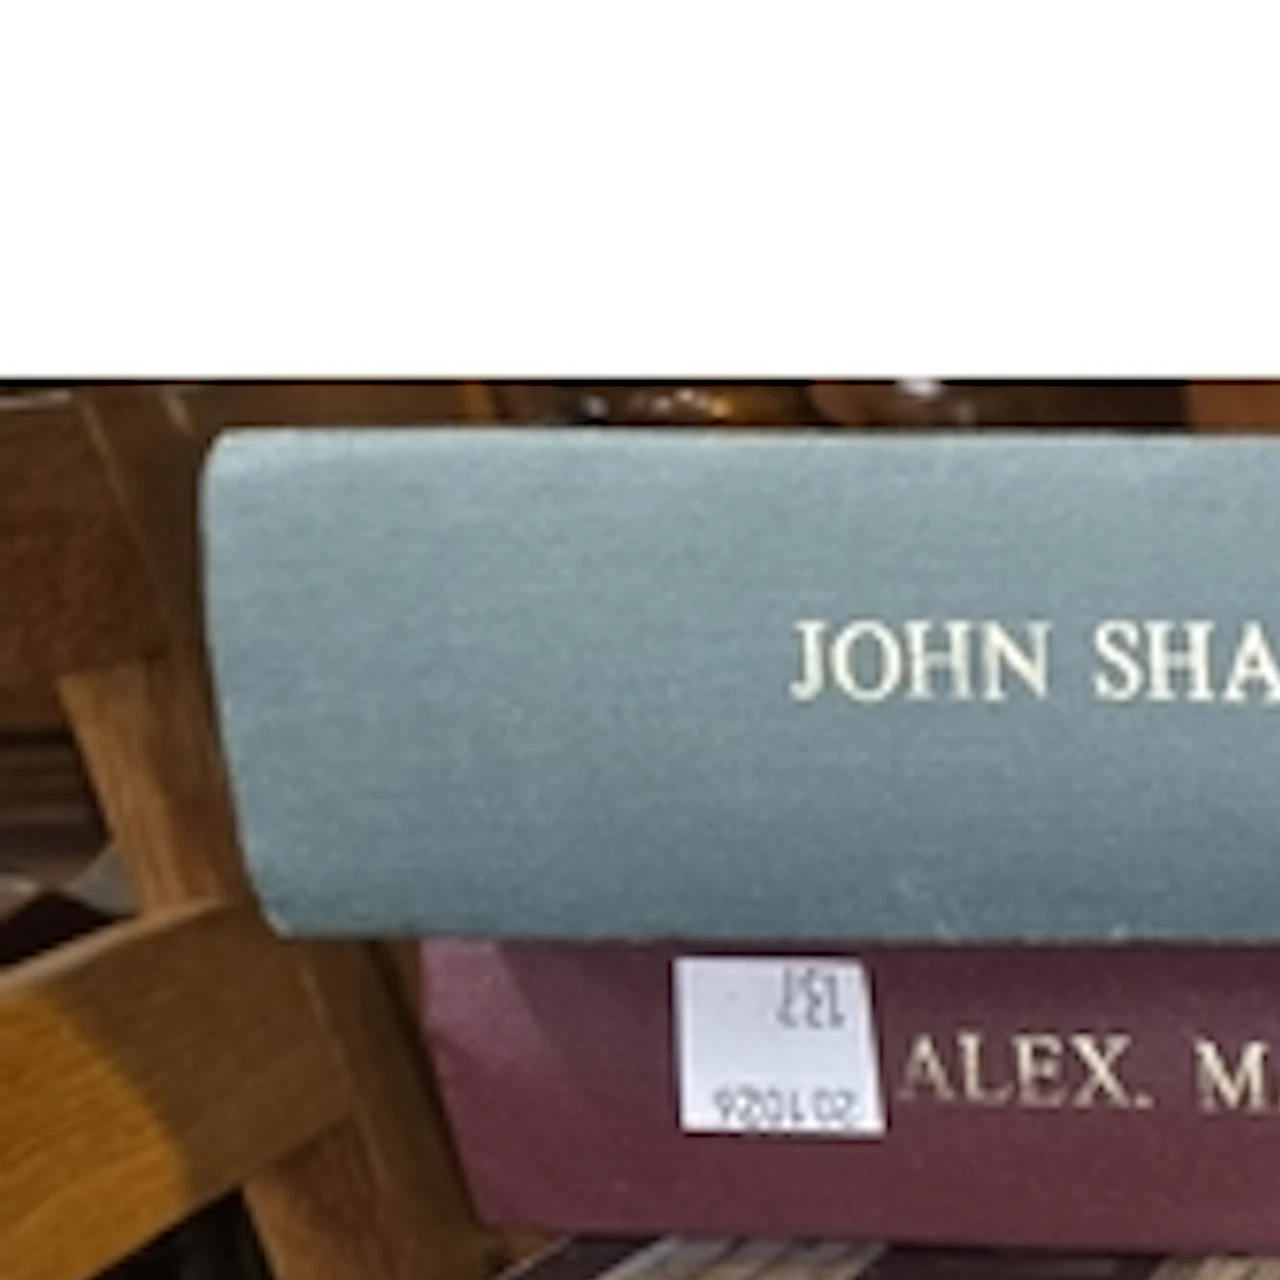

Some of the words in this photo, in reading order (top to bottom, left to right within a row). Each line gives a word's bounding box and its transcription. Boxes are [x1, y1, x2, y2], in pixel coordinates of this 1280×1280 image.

[788, 620, 1051, 706] JOHN
[776, 966, 845, 1030] 137
[901, 1030, 1155, 1110] ALEX.
